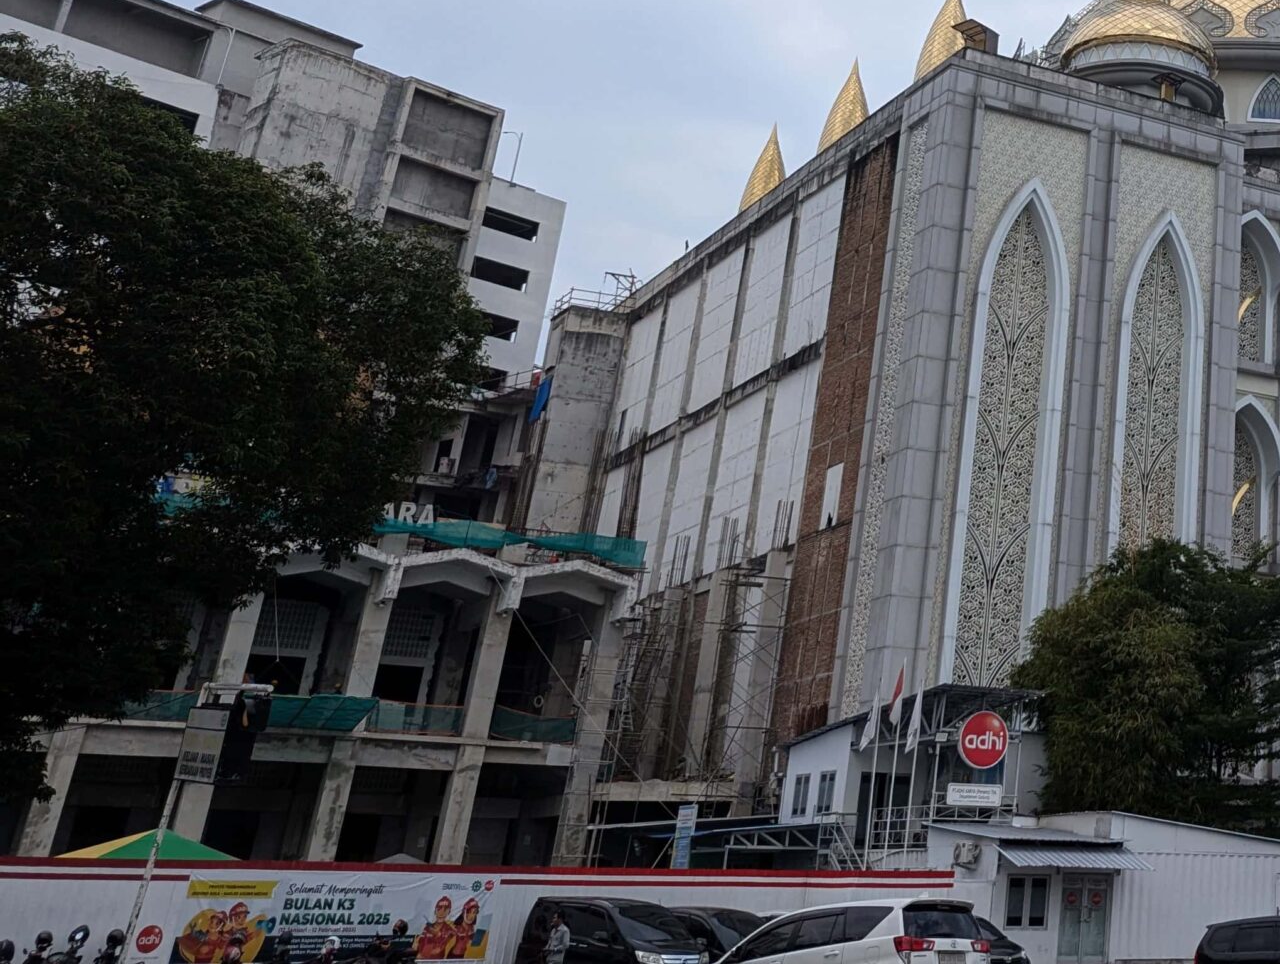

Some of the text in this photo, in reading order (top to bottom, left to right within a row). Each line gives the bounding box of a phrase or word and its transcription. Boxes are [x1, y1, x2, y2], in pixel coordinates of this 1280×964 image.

[965, 731, 1004, 750] adhi
[286, 883, 386, 897] Selamat Memperingati
[283, 898, 356, 911] BULAN K3
[279, 913, 390, 926] NASIONAL 2025
[139, 934, 161, 945] adhi
